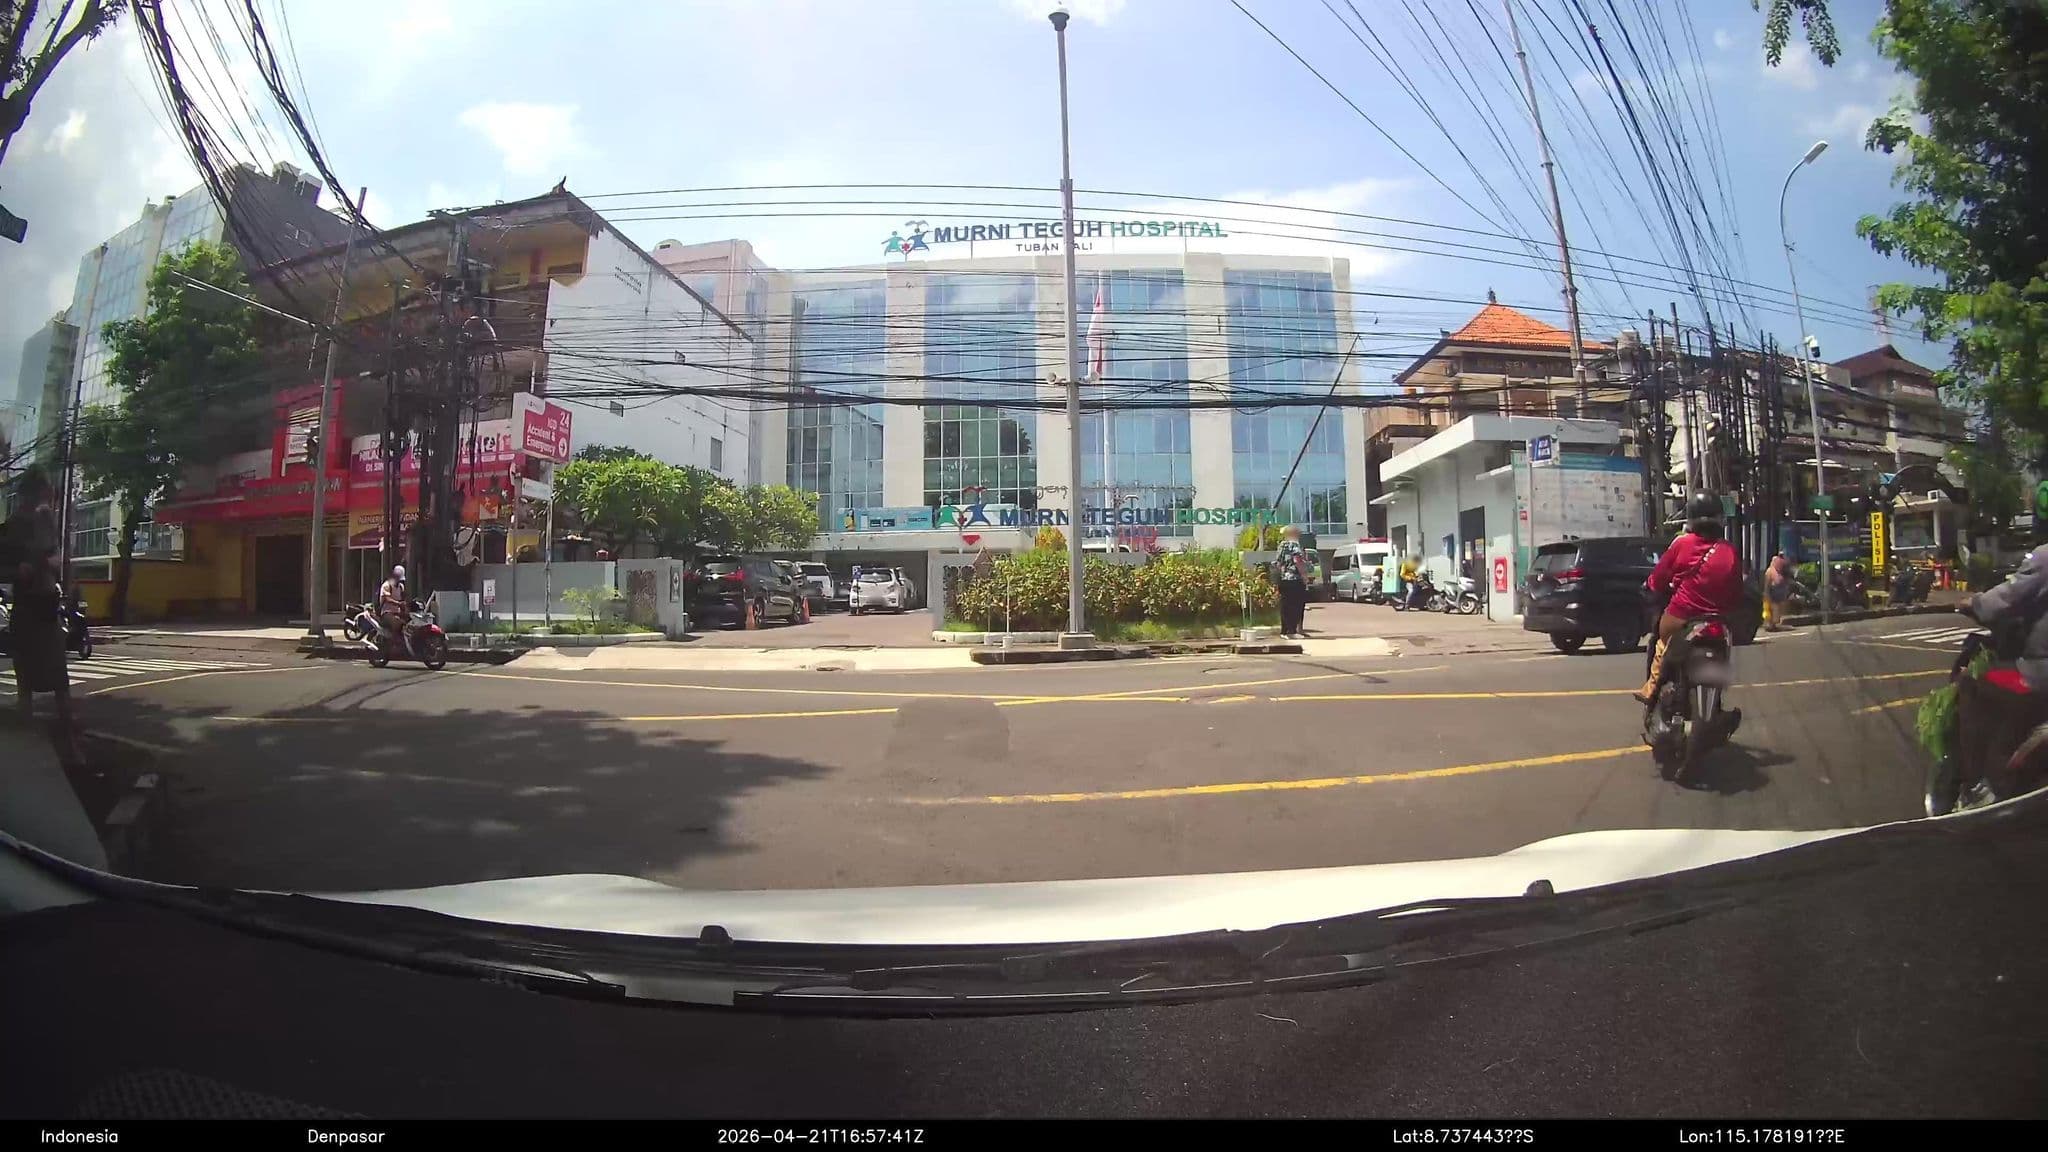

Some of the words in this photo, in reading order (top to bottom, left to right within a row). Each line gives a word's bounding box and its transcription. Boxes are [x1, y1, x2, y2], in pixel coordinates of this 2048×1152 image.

[934, 223, 1010, 243] MURNI
[1017, 220, 1101, 239] TEGUH
[1110, 220, 1228, 238] HOSPITAL
[1016, 243, 1058, 252] TUBAN
[1073, 242, 1093, 251] ALI
[560, 411, 570, 428] 24
[999, 508, 1069, 526] MURN
[1085, 507, 1168, 525] TEGUH
[1873, 514, 1881, 564] POLISI
